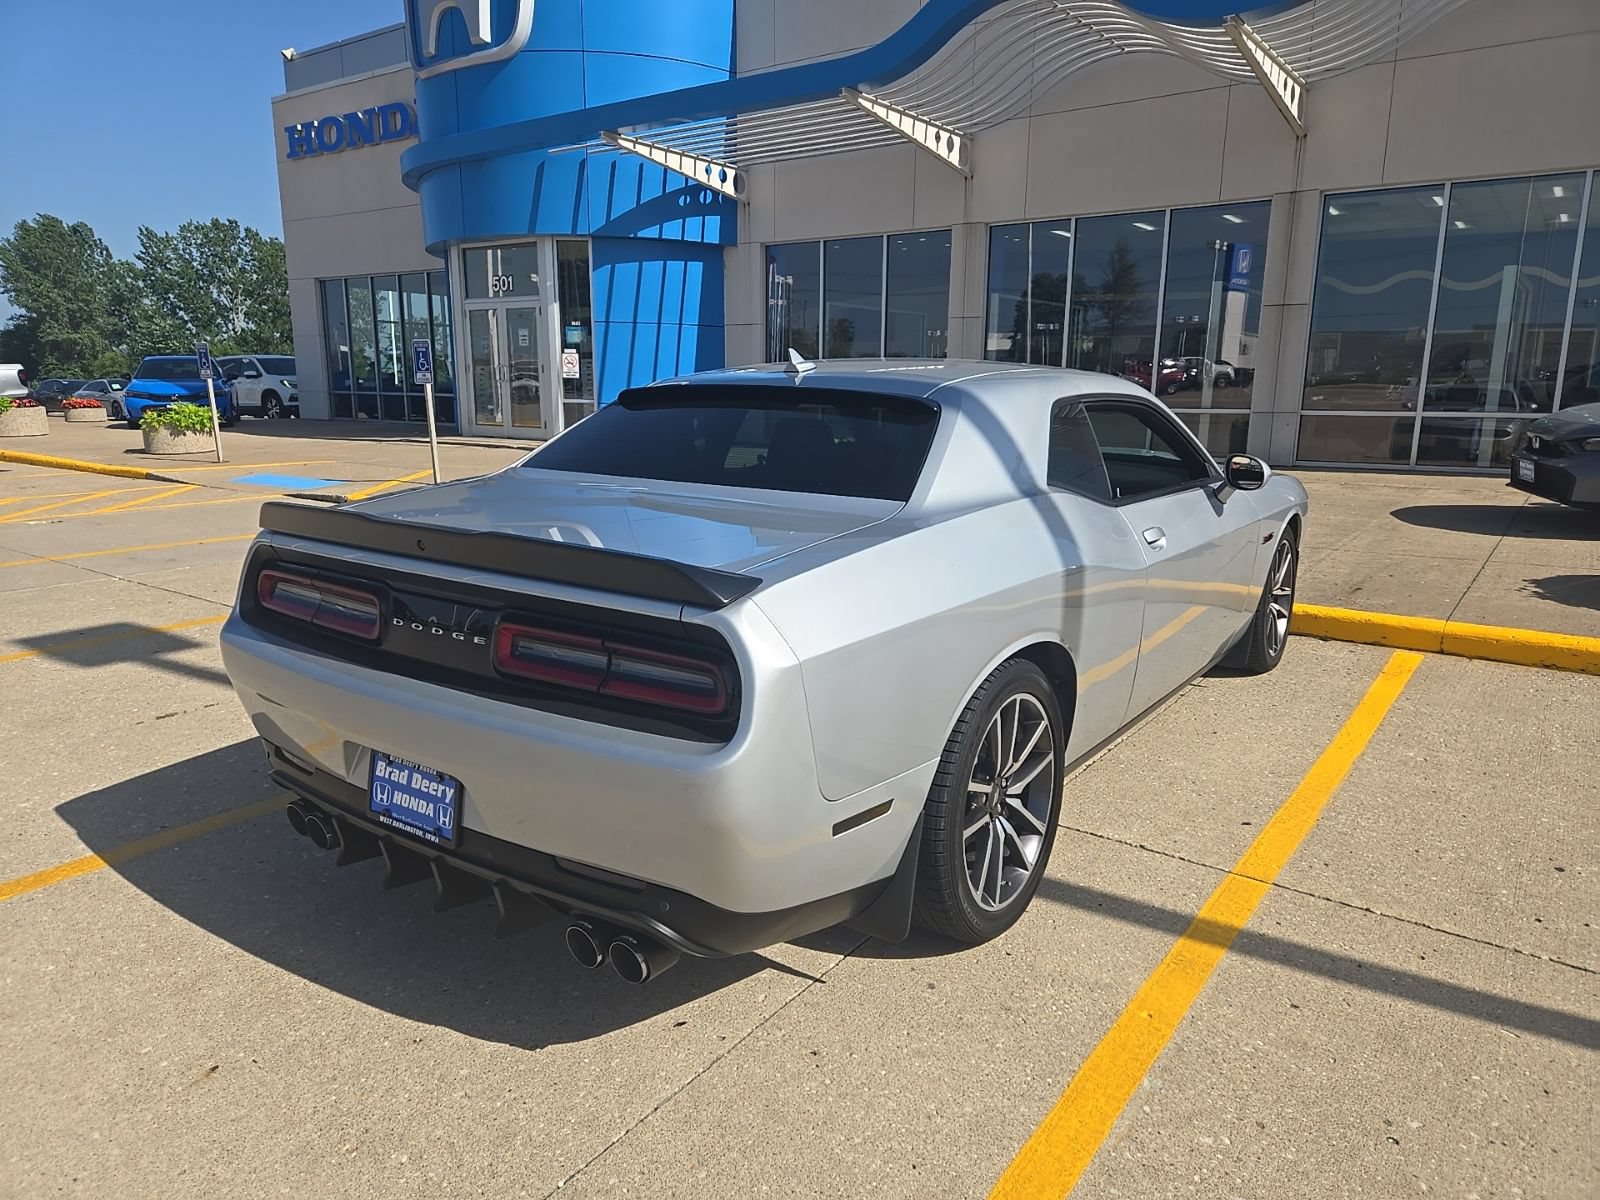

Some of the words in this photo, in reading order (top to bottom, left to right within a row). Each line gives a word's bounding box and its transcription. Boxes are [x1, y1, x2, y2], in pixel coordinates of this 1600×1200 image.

[284, 102, 419, 160] HOND
[492, 275, 513, 292] 501
[392, 618, 487, 645] DODGE
[375, 760, 409, 785] Brad
[411, 772, 454, 803] Deery
[392, 790, 434, 817] HONDA
[379, 815, 393, 825] WEST
